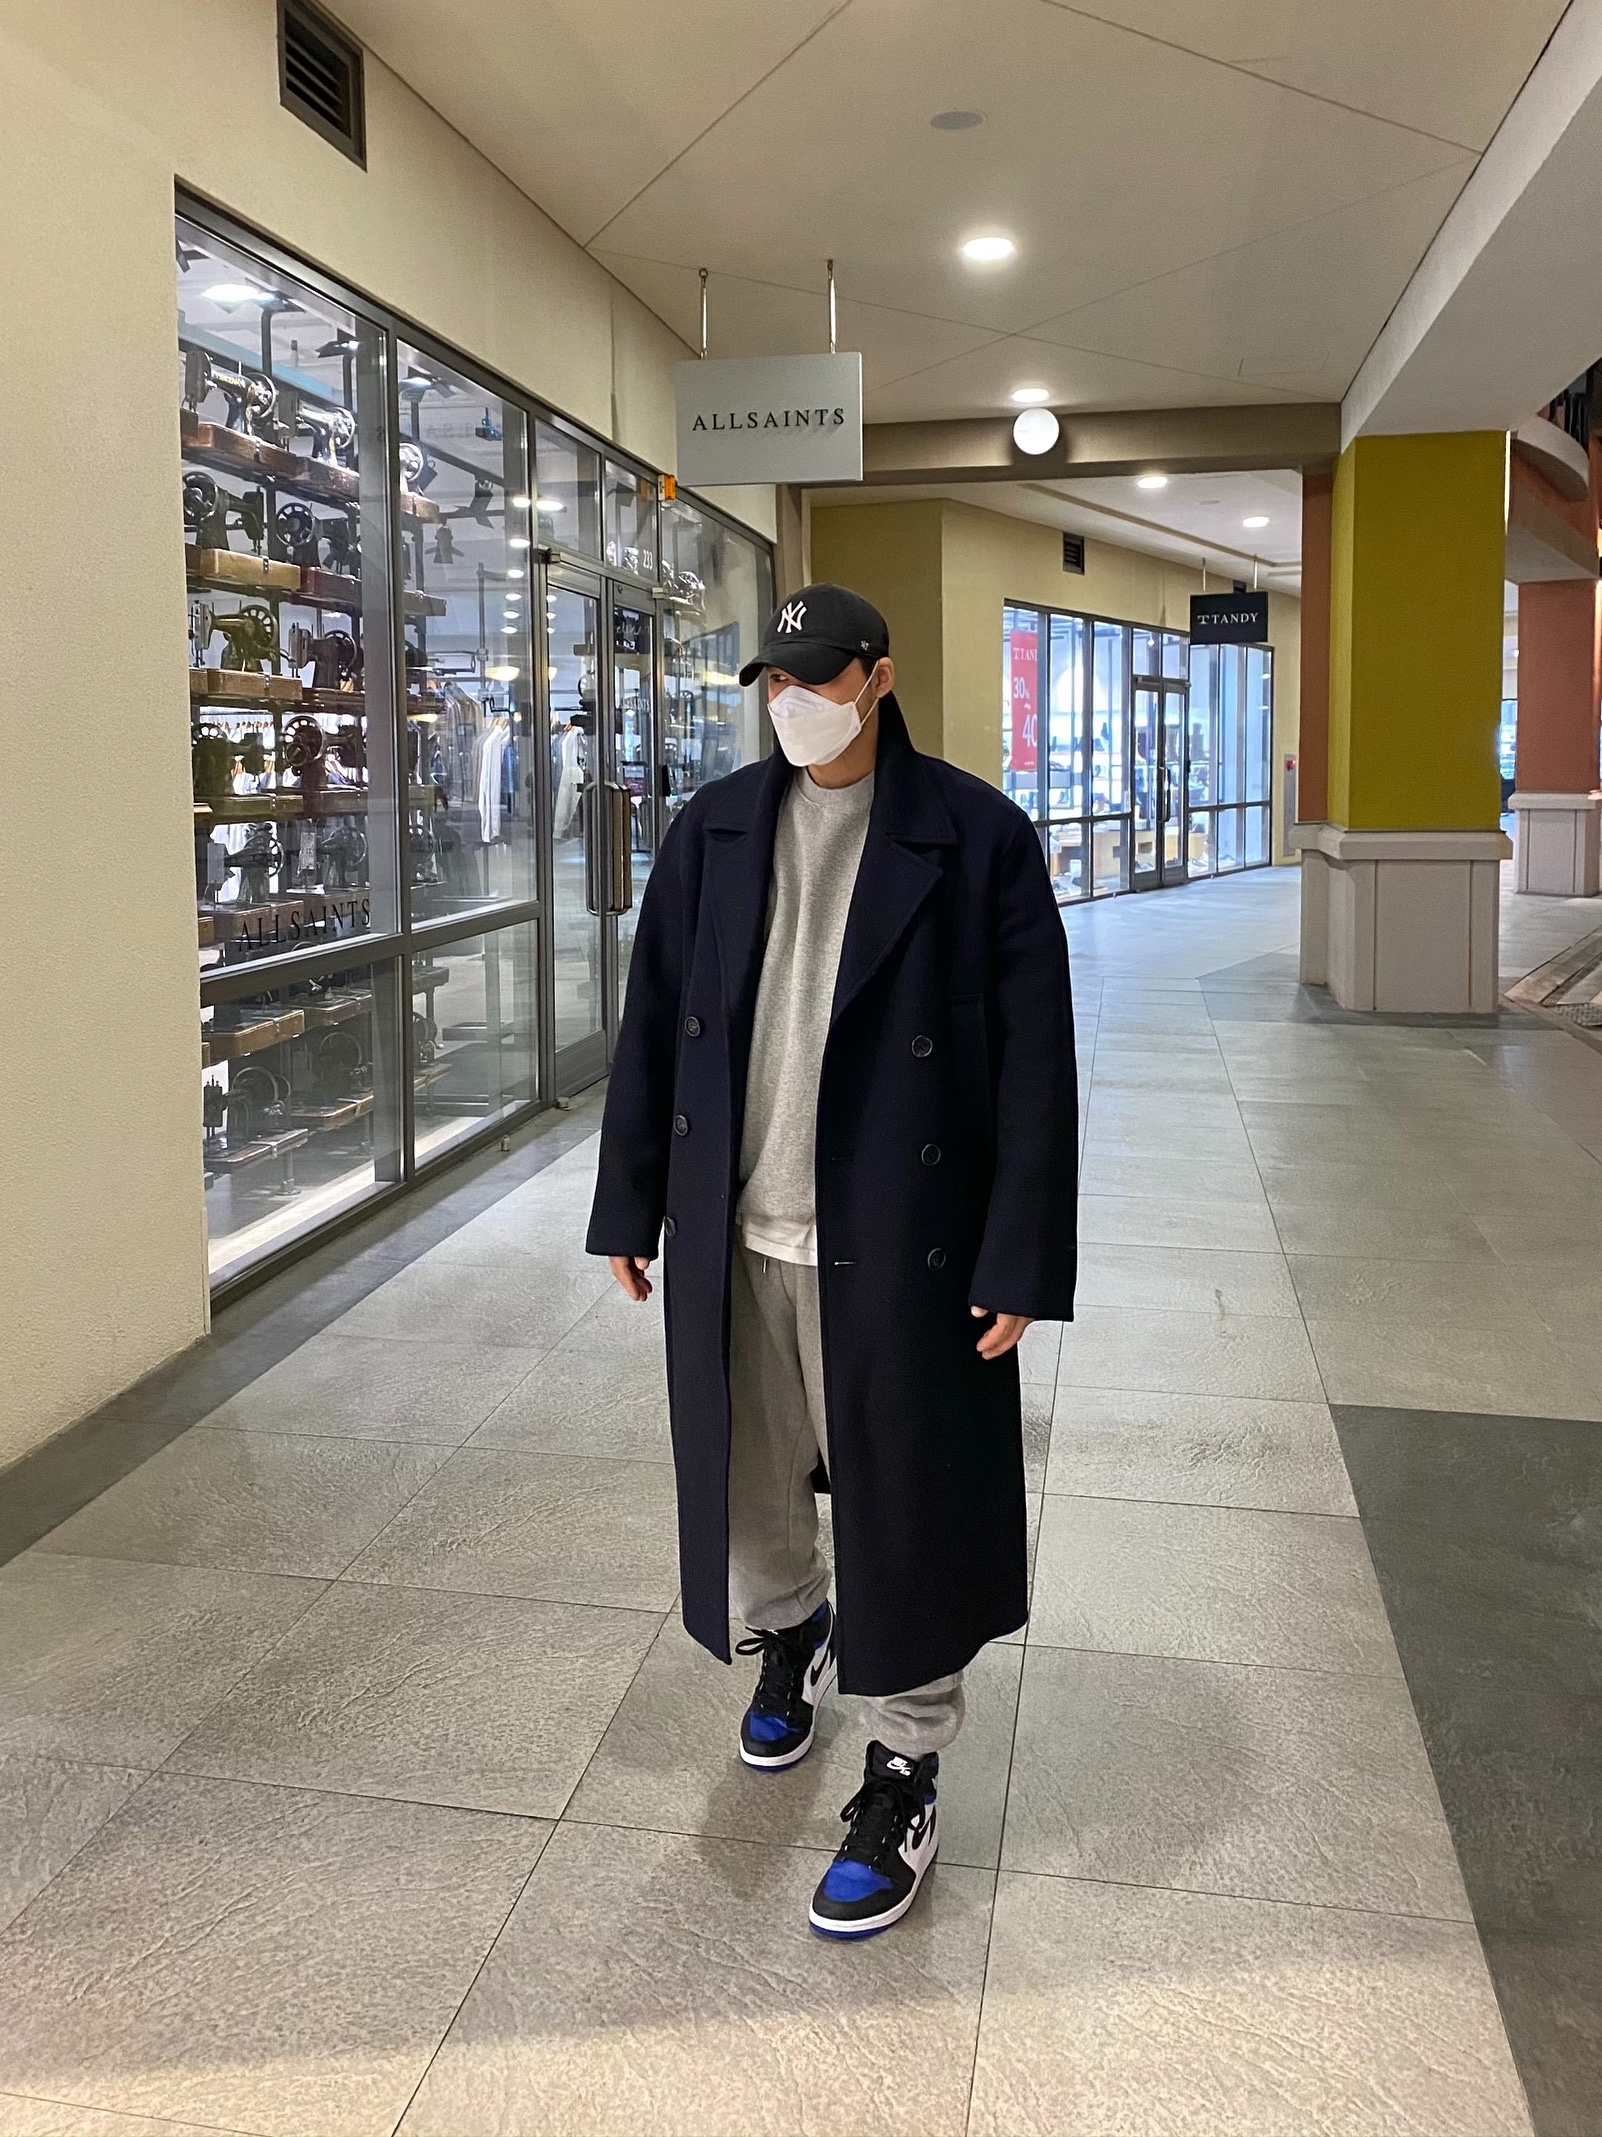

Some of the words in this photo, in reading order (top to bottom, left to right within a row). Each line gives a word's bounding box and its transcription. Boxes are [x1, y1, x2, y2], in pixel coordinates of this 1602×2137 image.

[692, 408, 845, 431] ALLSAINTS
[777, 601, 807, 633] NY
[238, 899, 370, 951] ALLSAINTS
